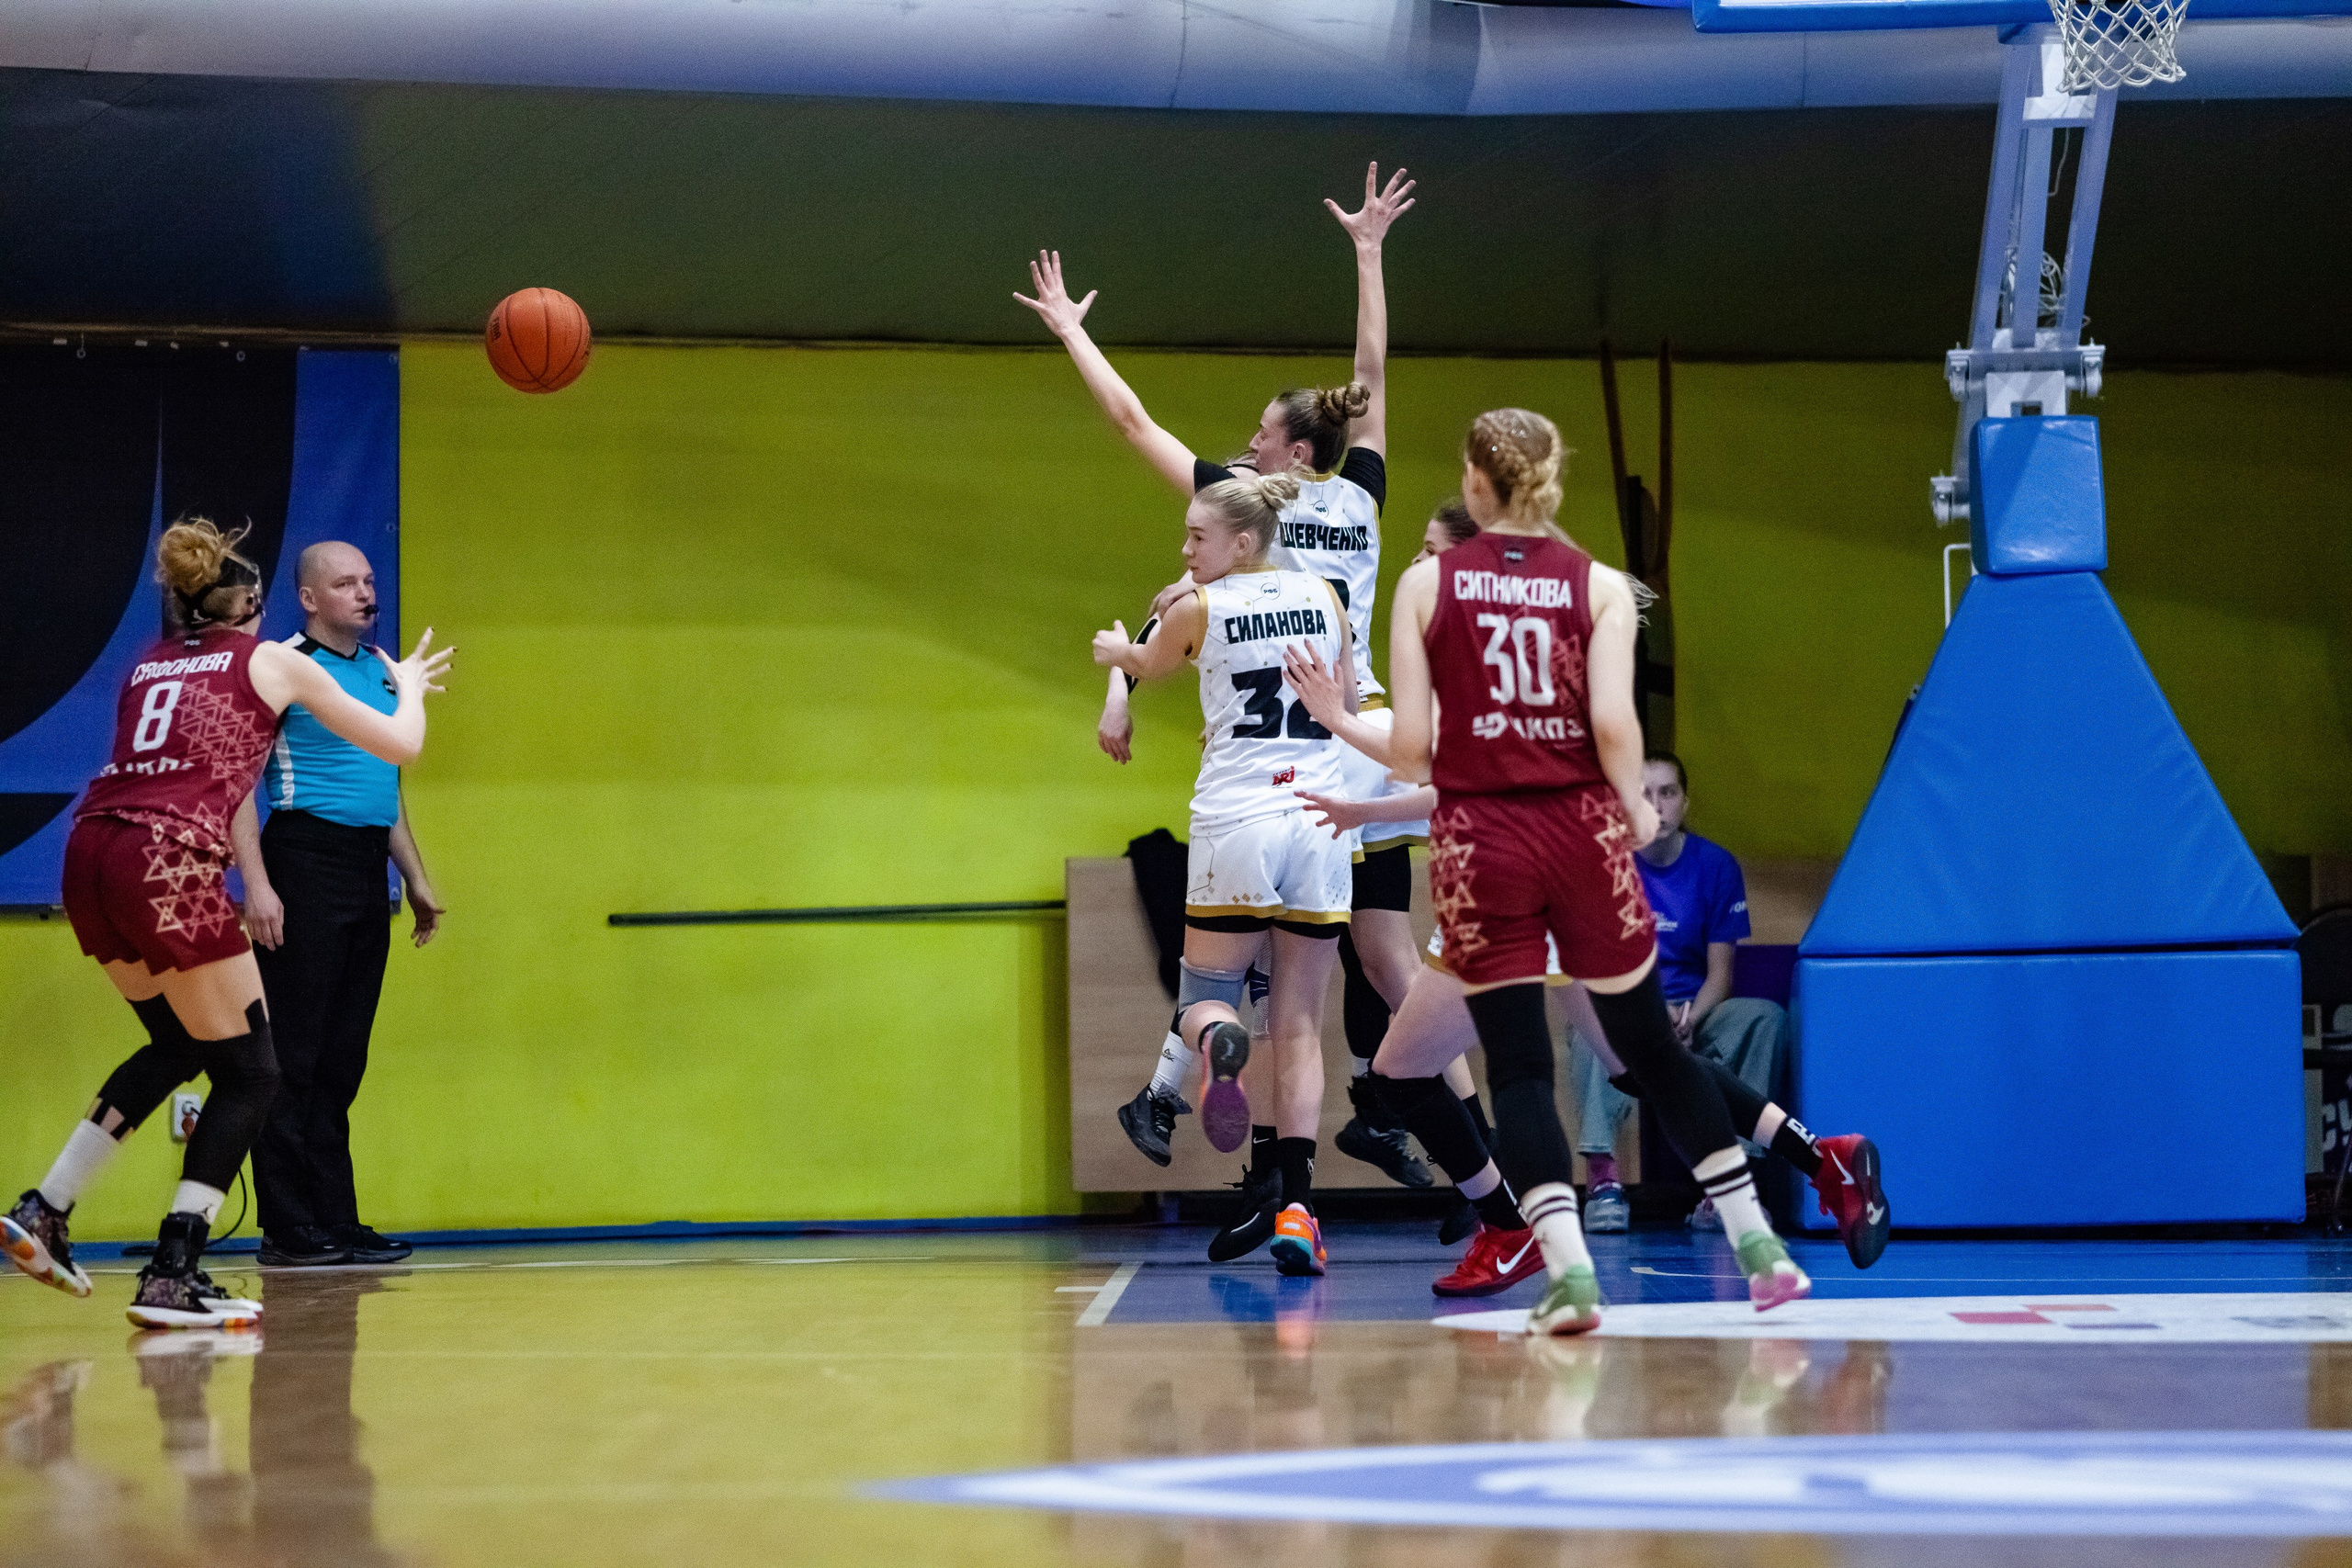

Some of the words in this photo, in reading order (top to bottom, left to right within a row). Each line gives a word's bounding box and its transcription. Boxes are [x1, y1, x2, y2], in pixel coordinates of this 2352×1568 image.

[1279, 522, 1369, 552] ШЕВЧЕНКО
[1453, 570, 1573, 609] СИТНИКОВА
[1225, 609, 1328, 644] СИЛАНОВА
[130, 651, 234, 687] САФОНОВА
[1476, 613, 1555, 706] 30
[132, 681, 183, 752] 8
